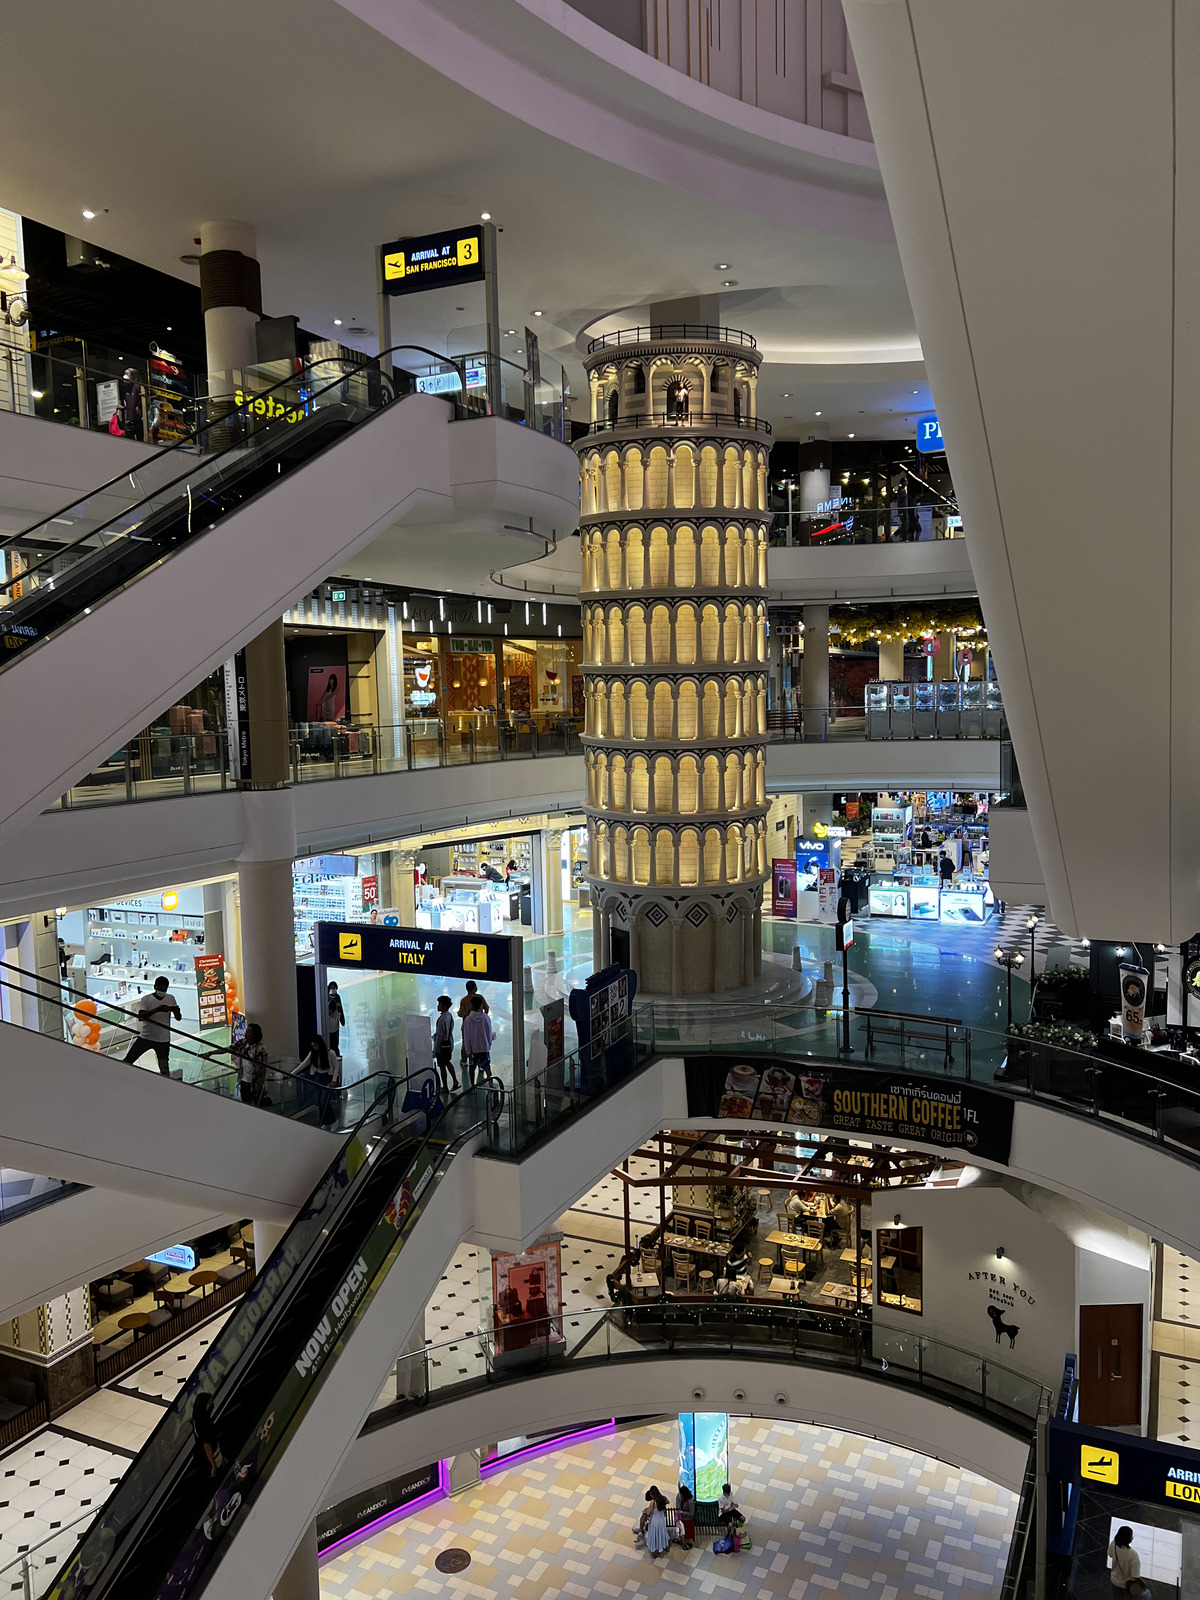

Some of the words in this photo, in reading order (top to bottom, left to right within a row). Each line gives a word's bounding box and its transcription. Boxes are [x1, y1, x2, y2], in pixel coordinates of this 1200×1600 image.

[411, 249, 439, 261] ARRIVAL
[442, 246, 450, 255] AT
[464, 244, 472, 260] 3
[406, 264, 419, 274] SAN
[421, 257, 457, 272] FRANCISCO
[238, 676, 246, 712] 東京メトロ
[390, 939, 420, 950] ARRIVAL
[424, 942, 434, 951] AT
[399, 952, 425, 965] ITALY
[470, 948, 477, 967] 1
[834, 1089, 908, 1121] SOUTHERN
[912, 1098, 961, 1130] COFFEE
[833, 1114, 860, 1128] GREAT
[866, 1119, 894, 1132] TASTE
[898, 1124, 926, 1137] GREAT
[931, 1130, 962, 1143] ORIGIN
[968, 1272, 1006, 1284] AFTER
[1013, 1282, 1036, 1305] YOU
[295, 1315, 332, 1378] NOW
[332, 1256, 368, 1318] OPEN
[334, 1278, 368, 1334] Hollywood
